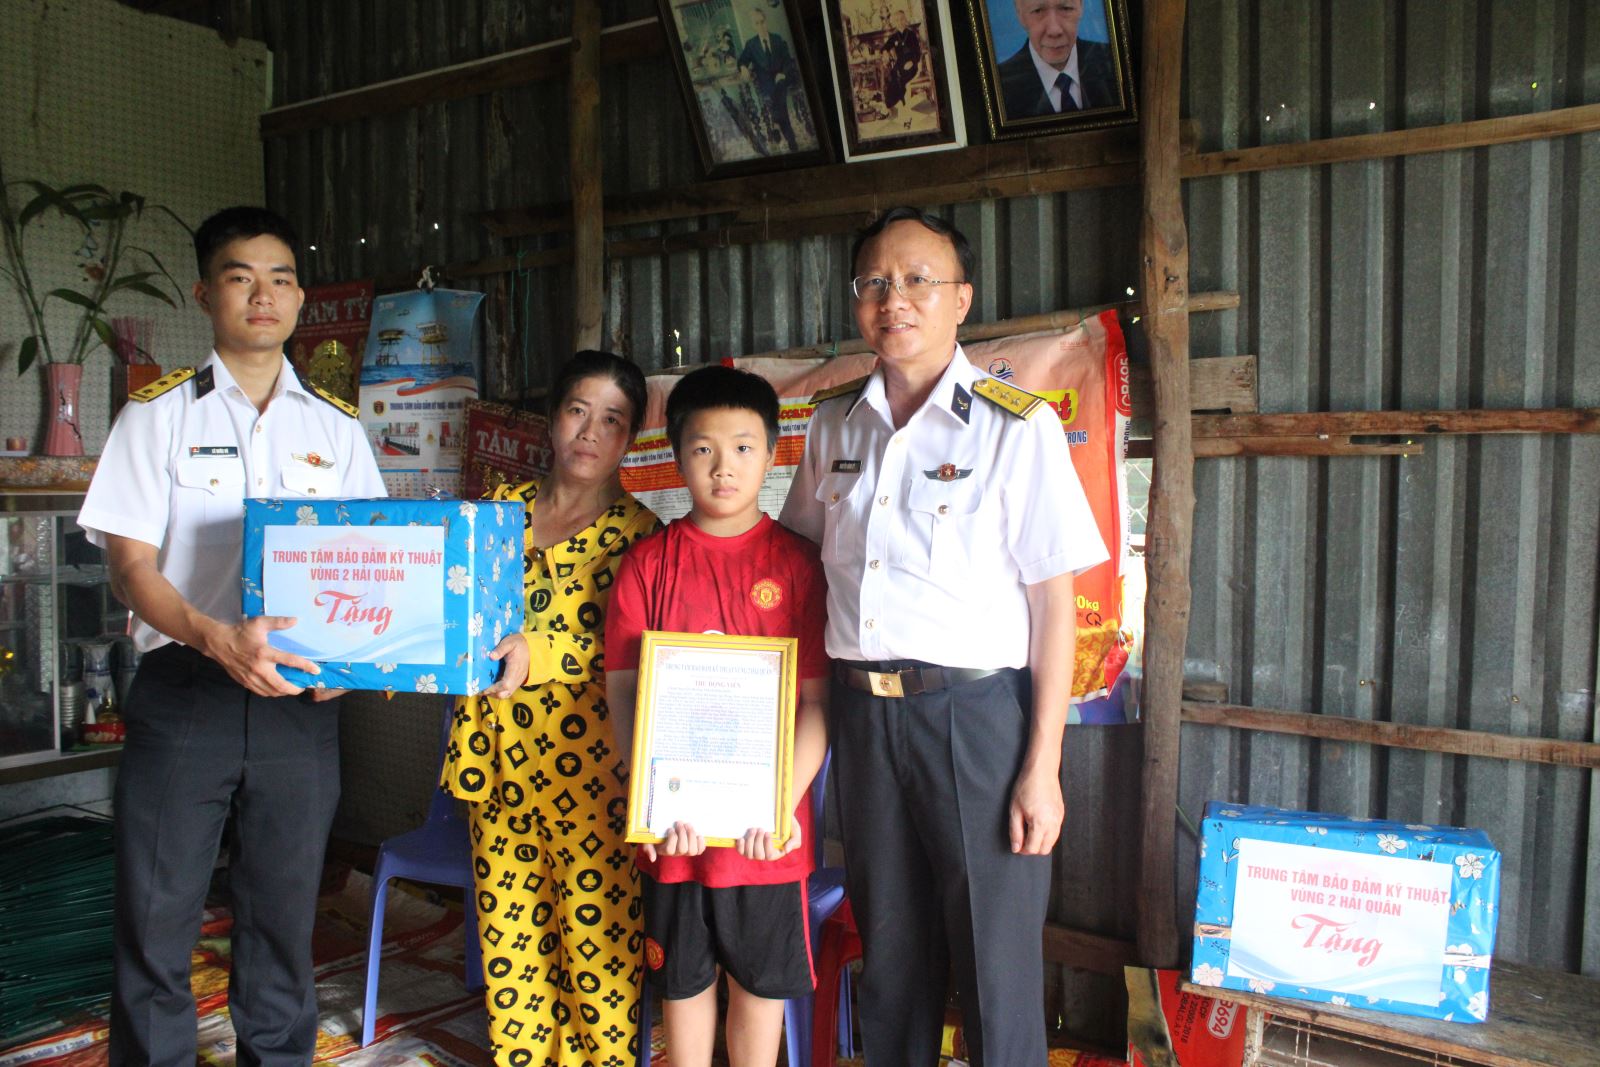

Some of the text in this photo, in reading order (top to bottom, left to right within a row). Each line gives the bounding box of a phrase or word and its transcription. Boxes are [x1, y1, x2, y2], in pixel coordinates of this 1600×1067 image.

[272, 547, 442, 567] TRUNG TÂM BẢO ĐẢM KỸ THUẬT
[310, 565, 405, 582] VÙNG 2 HẢI QUÂN
[314, 590, 393, 635] Tặng
[1247, 865, 1448, 906] TRUNG TÂM BẢO ĐẢM KỸ THUẬT
[1291, 888, 1402, 916] VÙNG 2 HẢI QUÂN
[1291, 913, 1383, 967] Tặng
